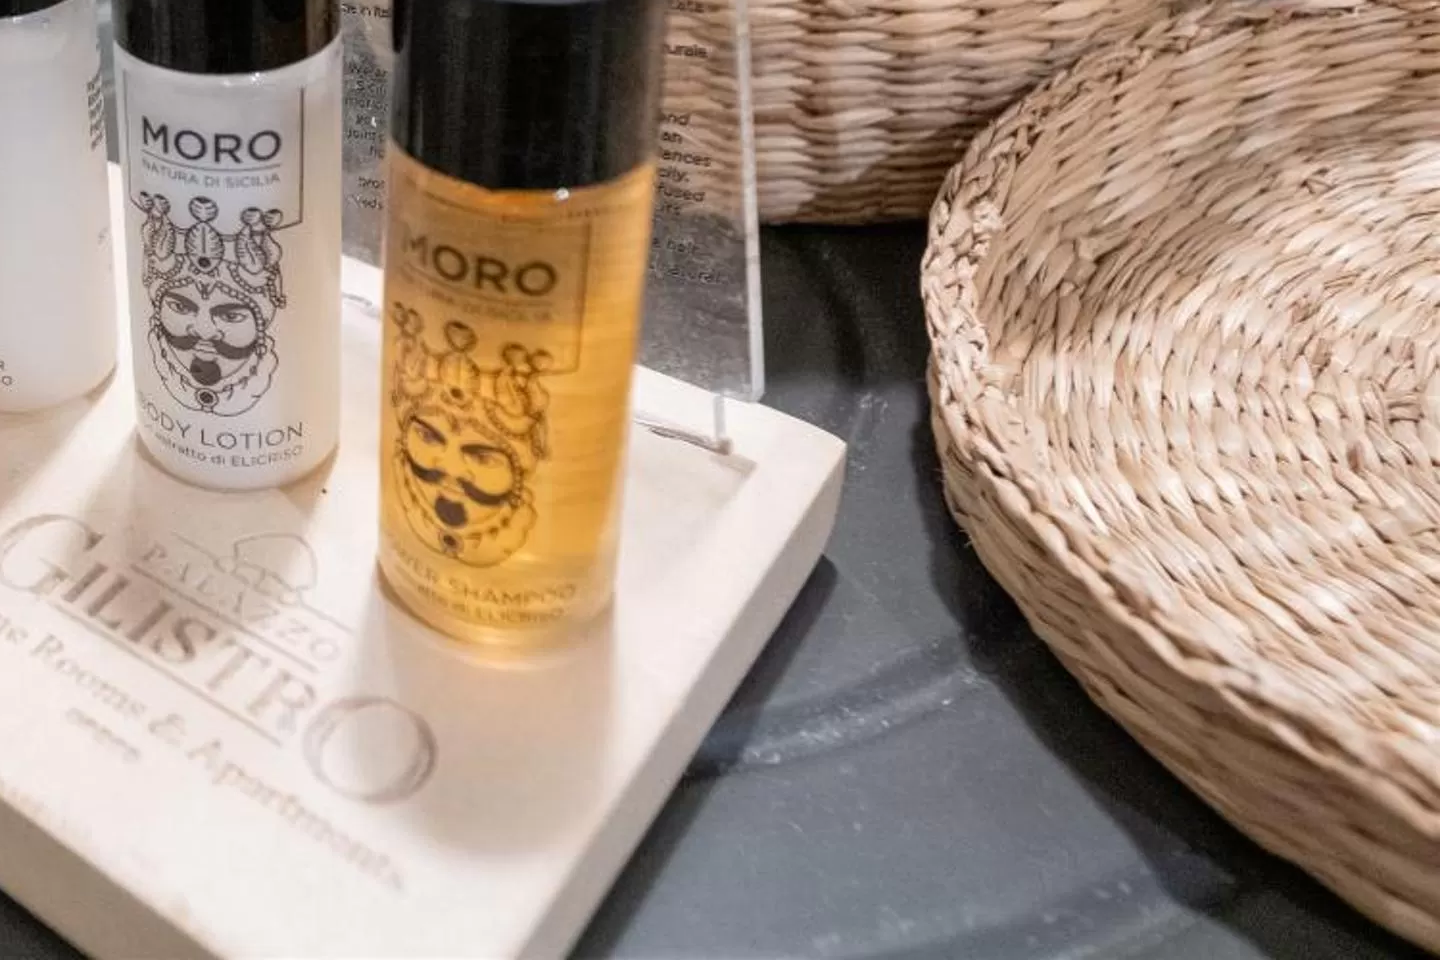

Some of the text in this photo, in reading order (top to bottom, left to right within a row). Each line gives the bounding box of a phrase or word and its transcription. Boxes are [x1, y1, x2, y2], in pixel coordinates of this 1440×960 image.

[141, 114, 282, 164] MORO
[142, 158, 281, 189] NATURA DI SICILIA
[402, 230, 558, 298] MORO
[141, 392, 304, 450] ODY LOTION
[231, 444, 305, 468] ELICRISO
[143, 543, 342, 662] PALAZZO
[29, 632, 148, 718] Rooms
